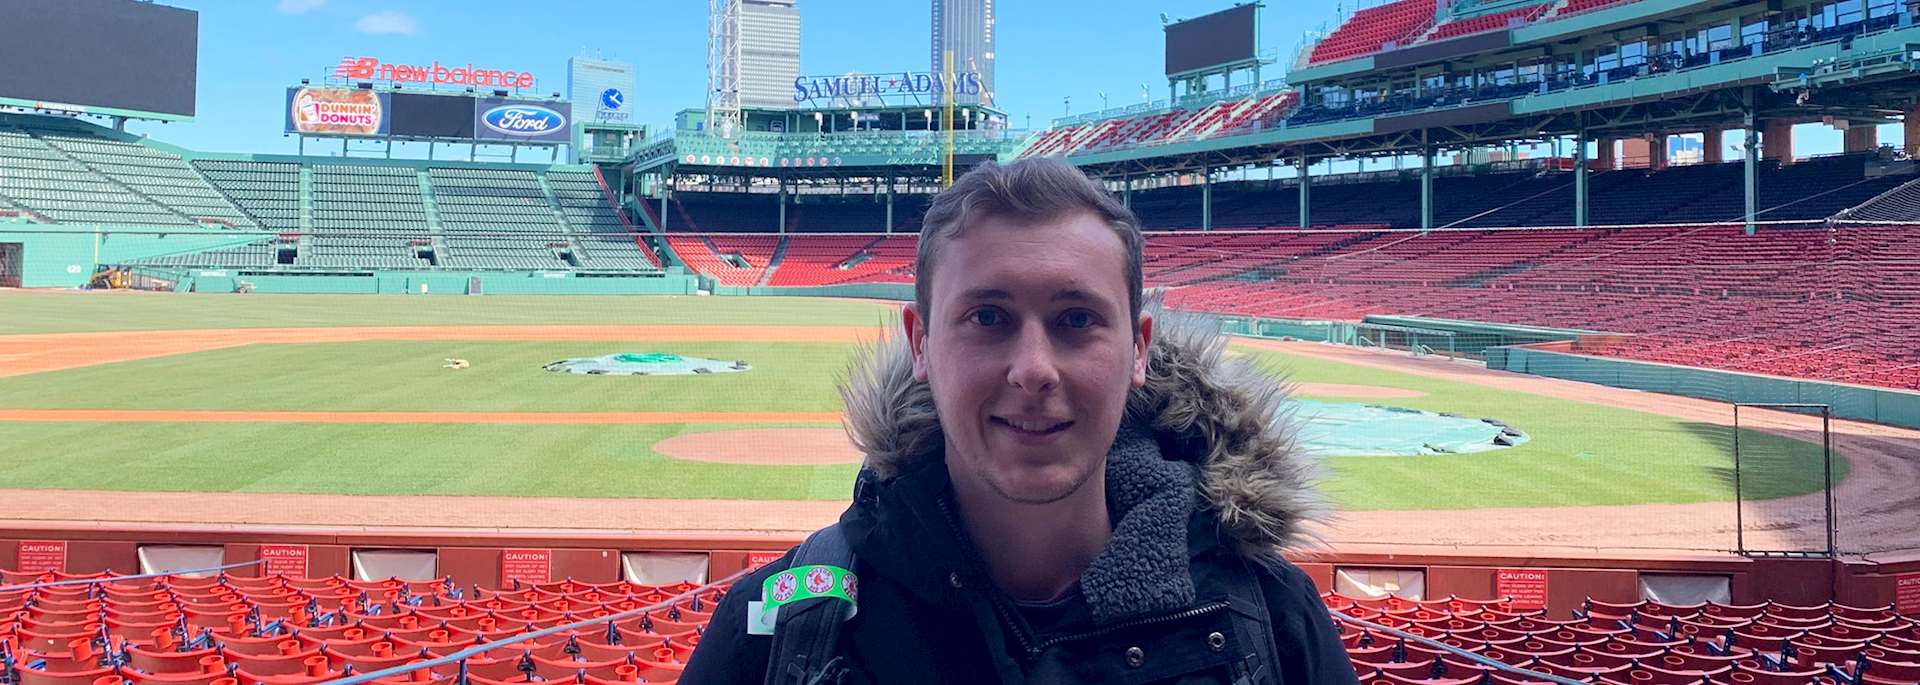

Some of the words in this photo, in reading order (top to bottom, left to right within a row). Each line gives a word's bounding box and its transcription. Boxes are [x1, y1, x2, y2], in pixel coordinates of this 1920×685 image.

[379, 63, 430, 82] new
[432, 61, 534, 88] balance
[793, 75, 886, 102] SAMUEL
[897, 71, 982, 96] ADAMS
[320, 103, 376, 114] DUNKIN'
[320, 113, 372, 125] DONUTS
[499, 108, 549, 131] Ford
[505, 553, 548, 561] CAUTION!
[1500, 572, 1545, 580] CAUTION!
